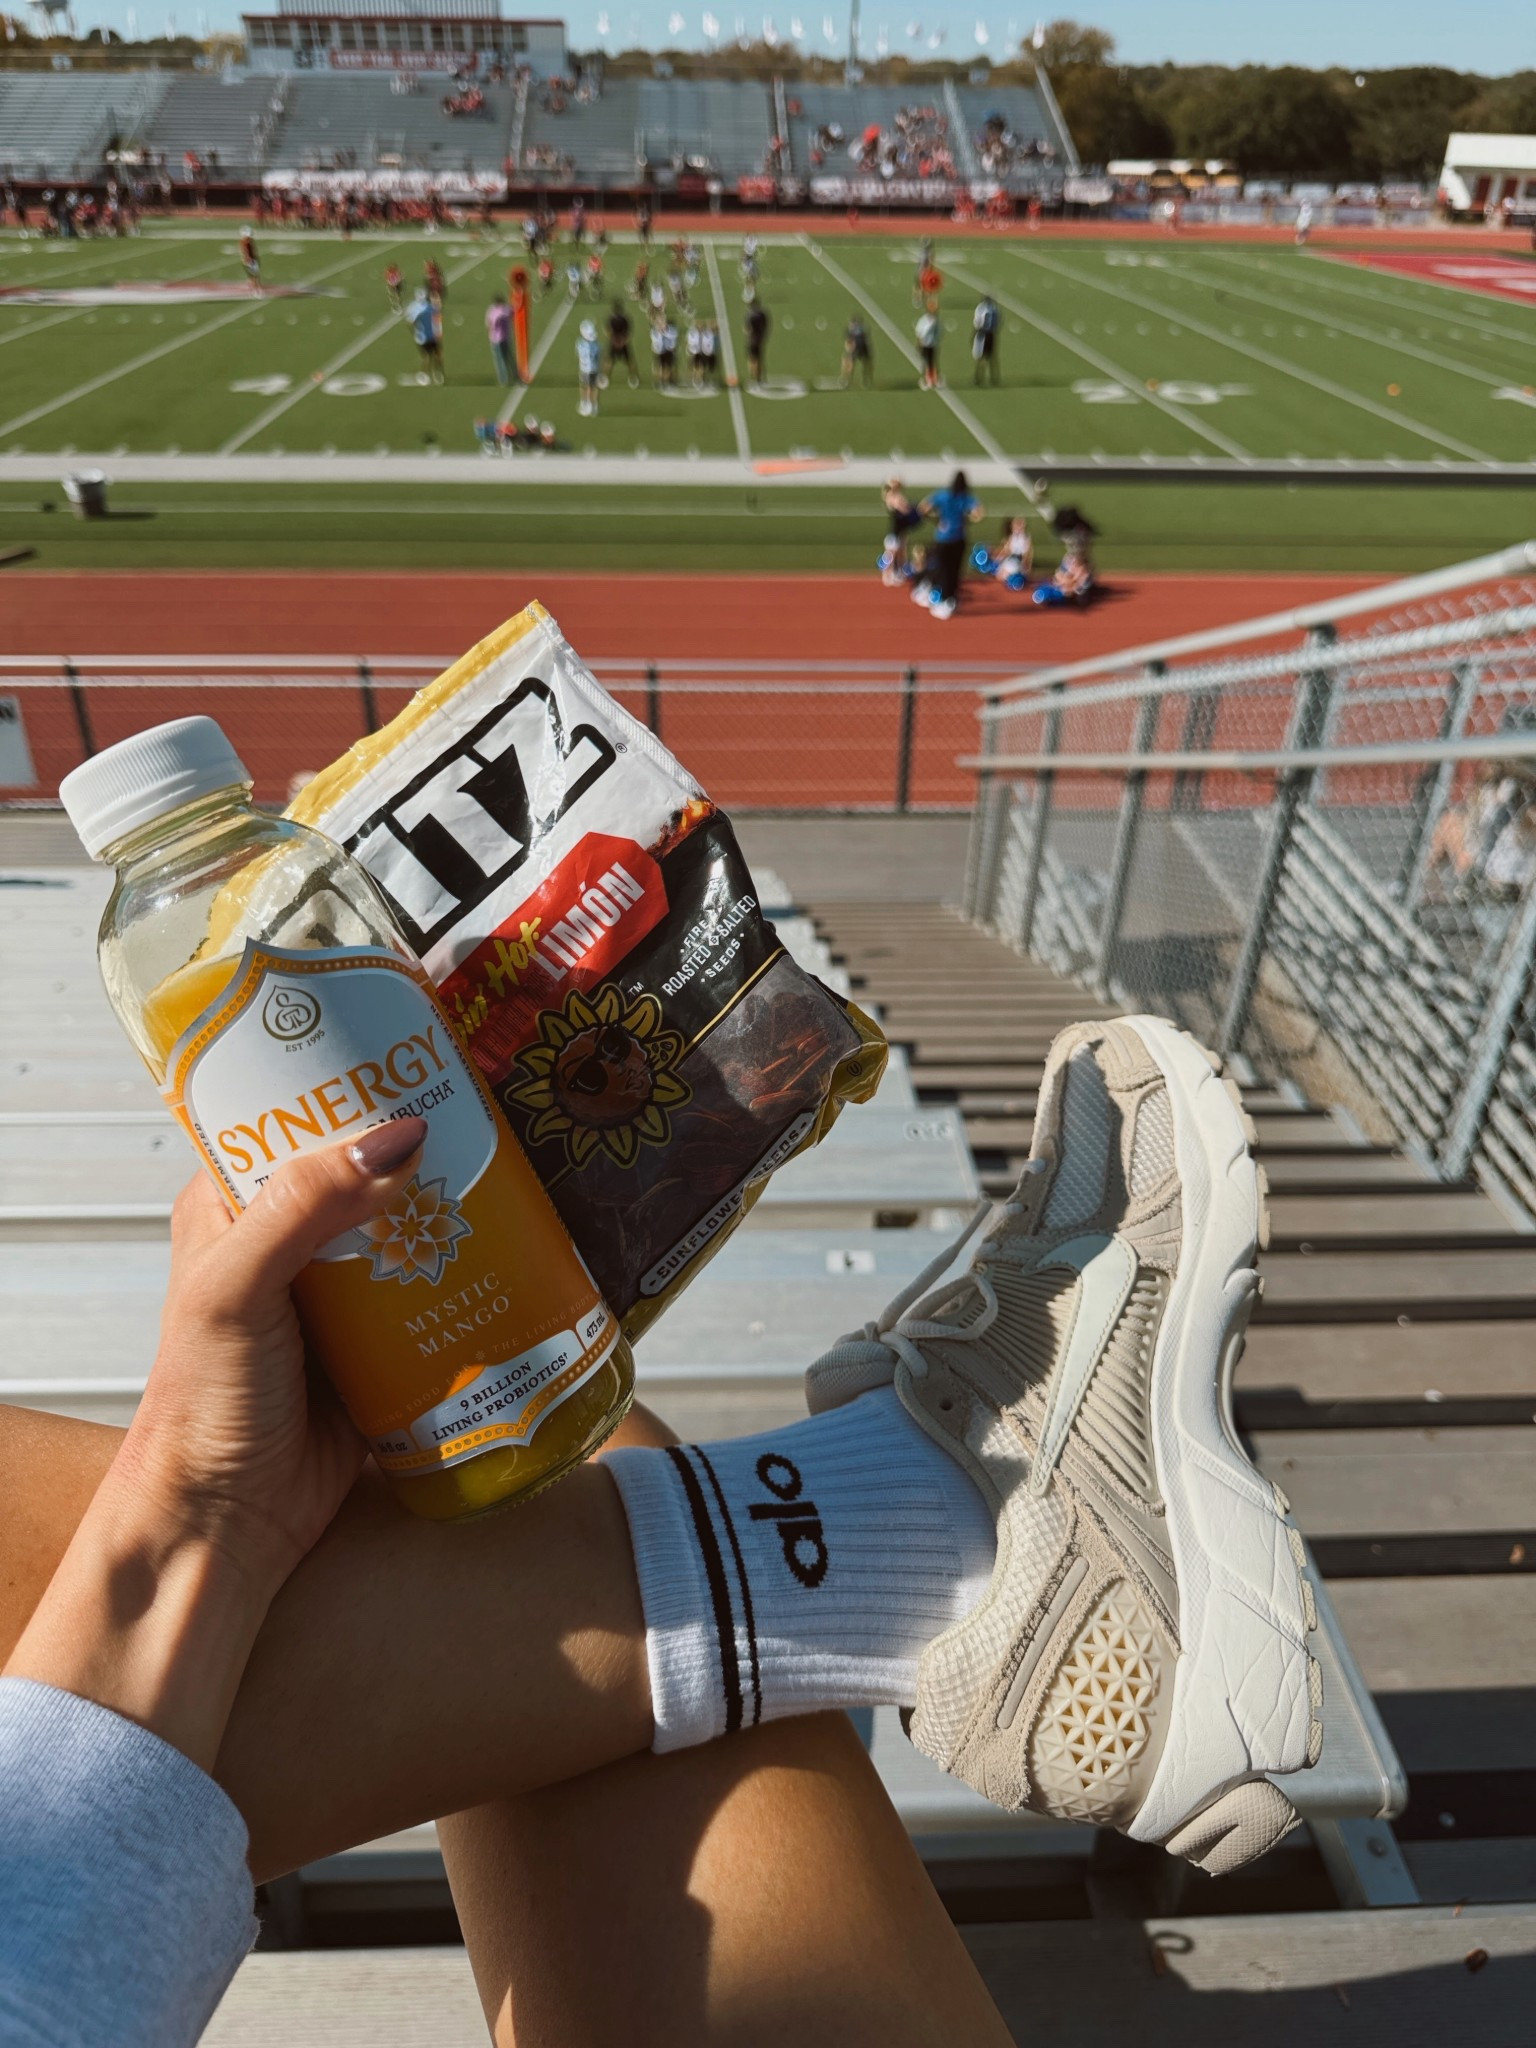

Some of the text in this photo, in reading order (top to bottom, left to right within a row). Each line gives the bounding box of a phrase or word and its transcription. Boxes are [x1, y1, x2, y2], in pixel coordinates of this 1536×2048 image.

[345, 677, 616, 952] ITZ
[529, 861, 646, 982] LIMÓN
[662, 945, 712, 997] ROASTED
[716, 895, 757, 937] SALTED
[683, 919, 710, 949] FIRE
[705, 938, 741, 978] SEEDS
[285, 1028, 326, 1053] EST 1995
[430, 1003, 494, 1122] NEVER PASTEURIZED
[217, 1024, 447, 1174] SYNERGY
[194, 1122, 241, 1200] FERMENTED
[404, 1271, 501, 1337] MYSTIC
[416, 1294, 511, 1359] MANGO
[585, 1320, 599, 1339] 473
[459, 1361, 532, 1412] 9 BILLION
[432, 1411, 484, 1441] LIVING
[748, 1452, 829, 1588] alo
